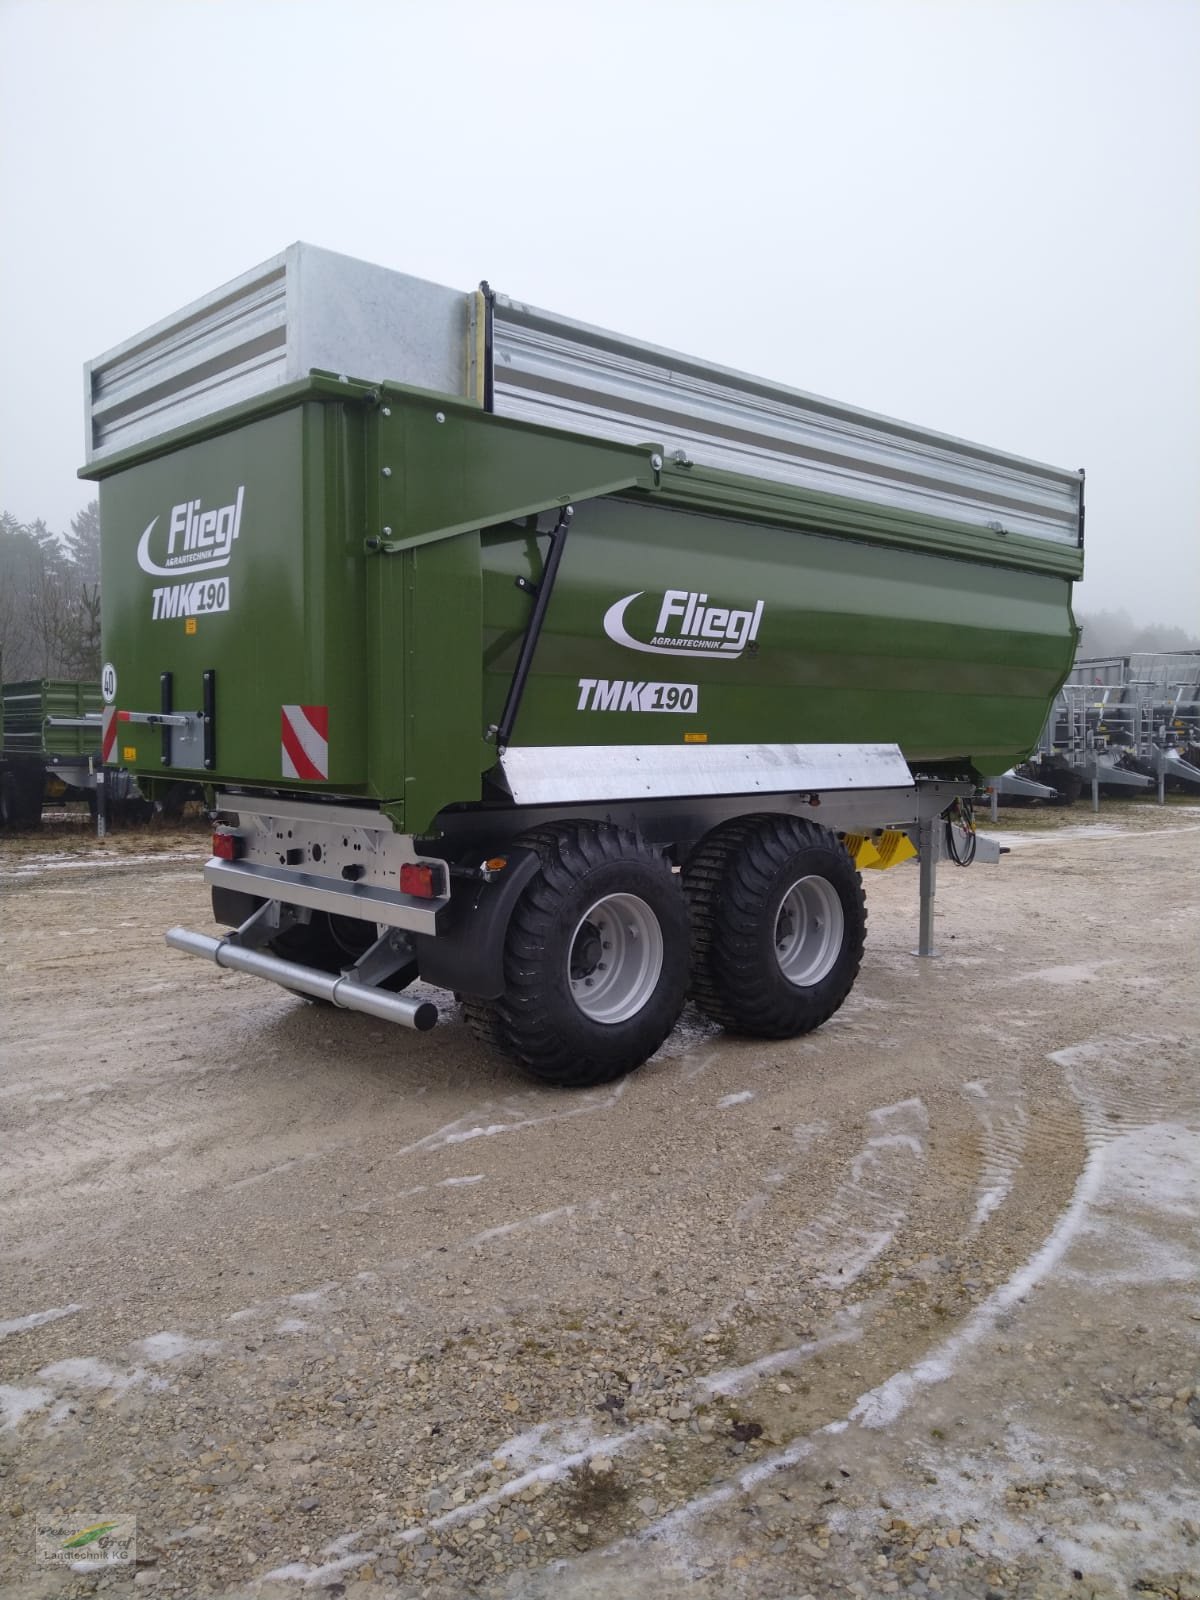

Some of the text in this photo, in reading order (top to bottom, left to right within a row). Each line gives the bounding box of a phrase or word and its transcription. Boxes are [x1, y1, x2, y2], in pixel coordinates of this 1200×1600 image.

[168, 486, 245, 556] Fliegl
[165, 549, 214, 567] AGRARTECHNIK
[152, 582, 226, 620] TMK 190
[656, 590, 765, 651] Fliegl
[650, 636, 721, 649] AGRARTECHNIK
[104, 671, 114, 696] 40
[577, 678, 694, 712] TMK 190
